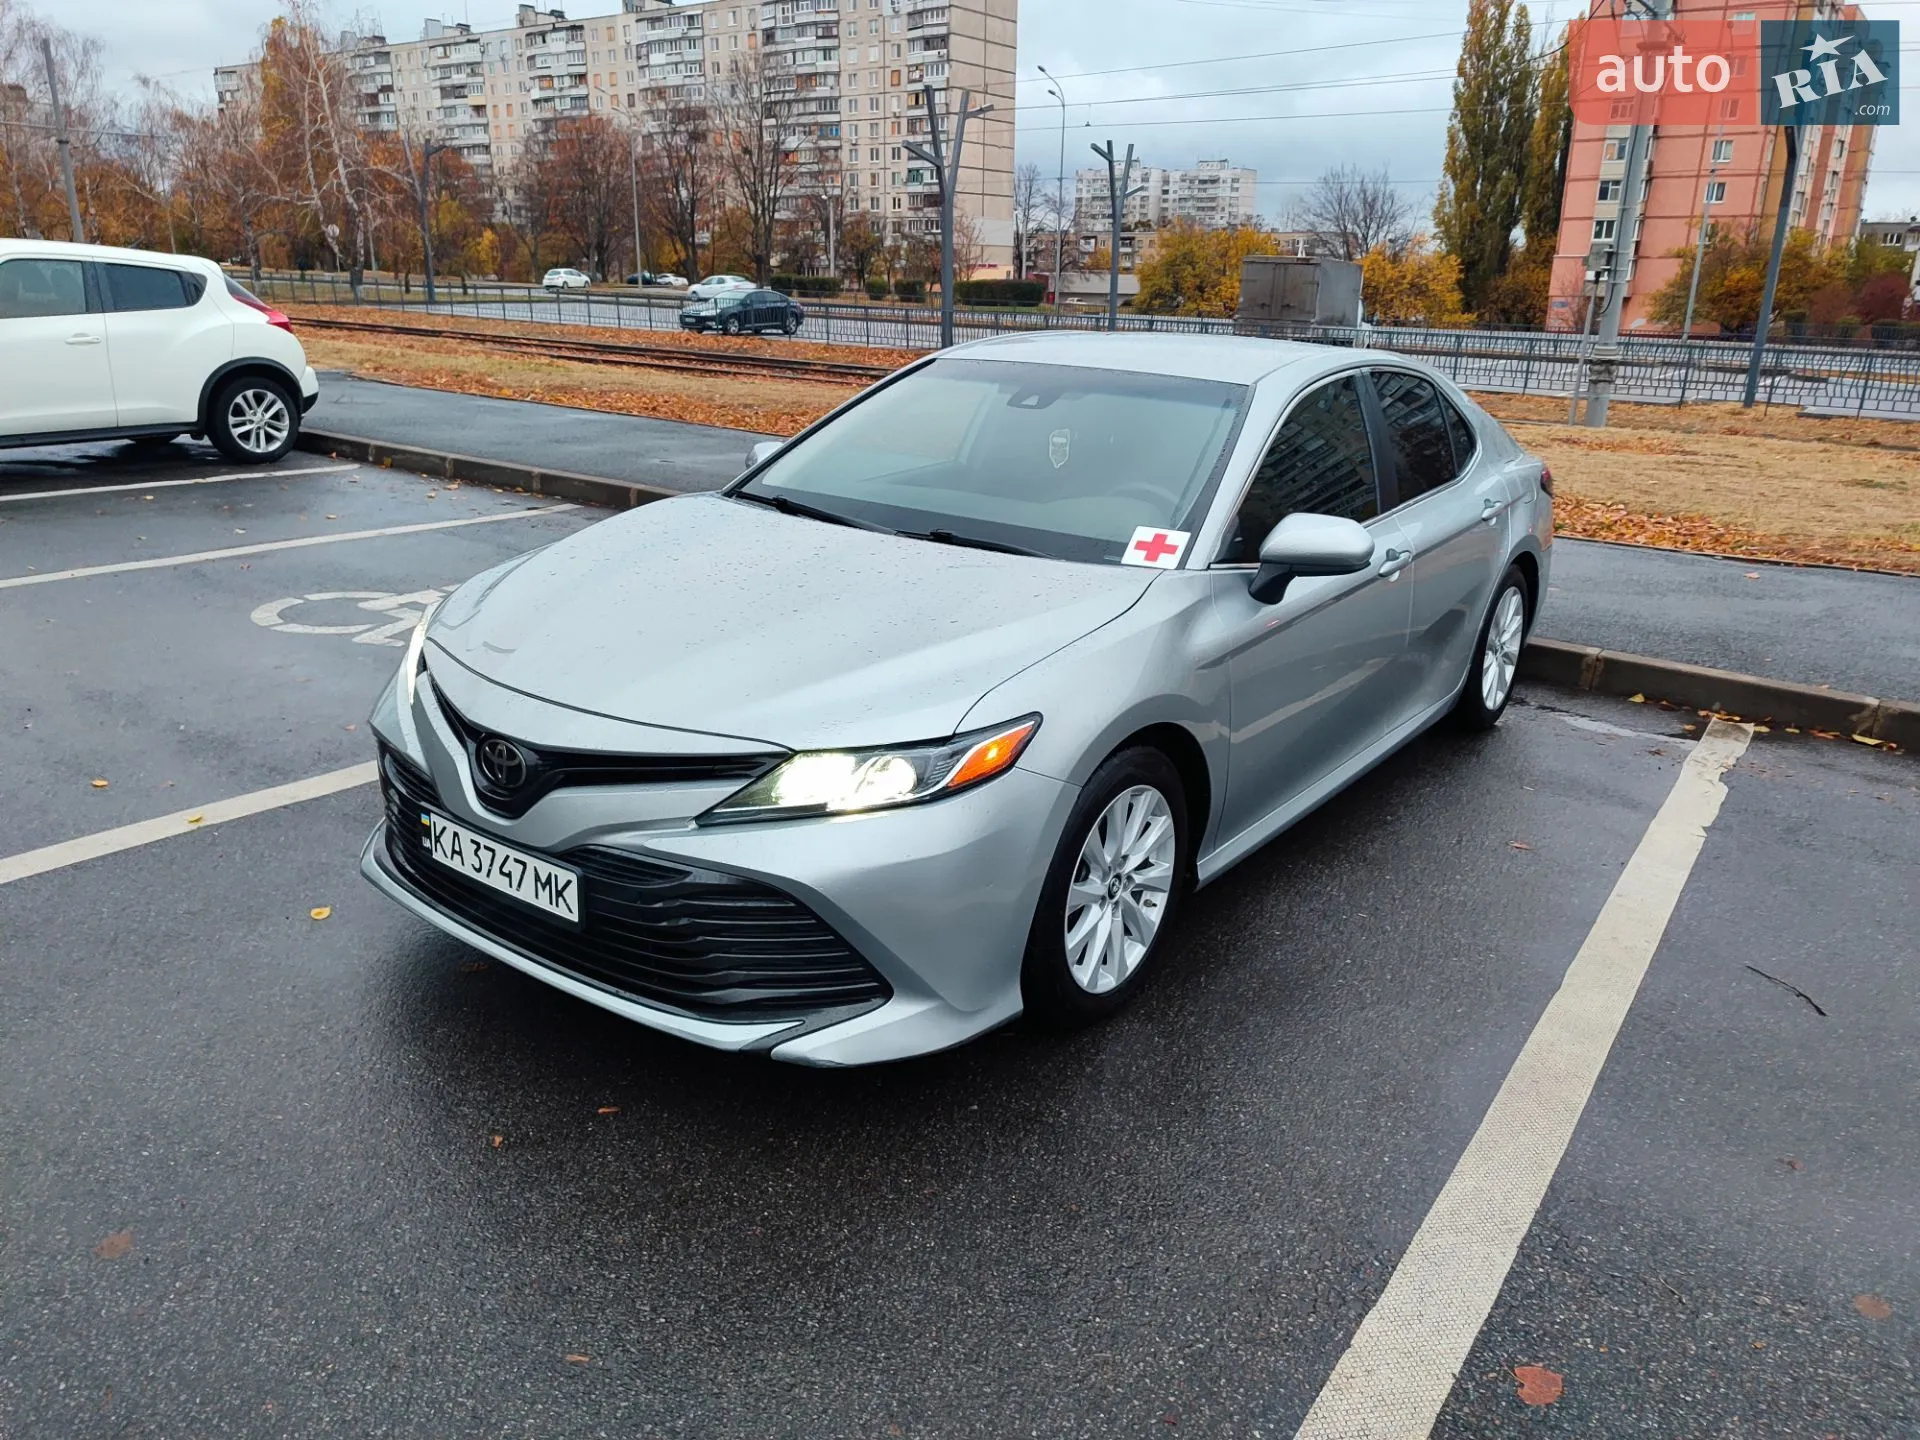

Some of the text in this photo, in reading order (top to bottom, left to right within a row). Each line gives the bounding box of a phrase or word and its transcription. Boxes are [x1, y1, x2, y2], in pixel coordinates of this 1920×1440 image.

[433, 820, 574, 914] KA 3747 MK
